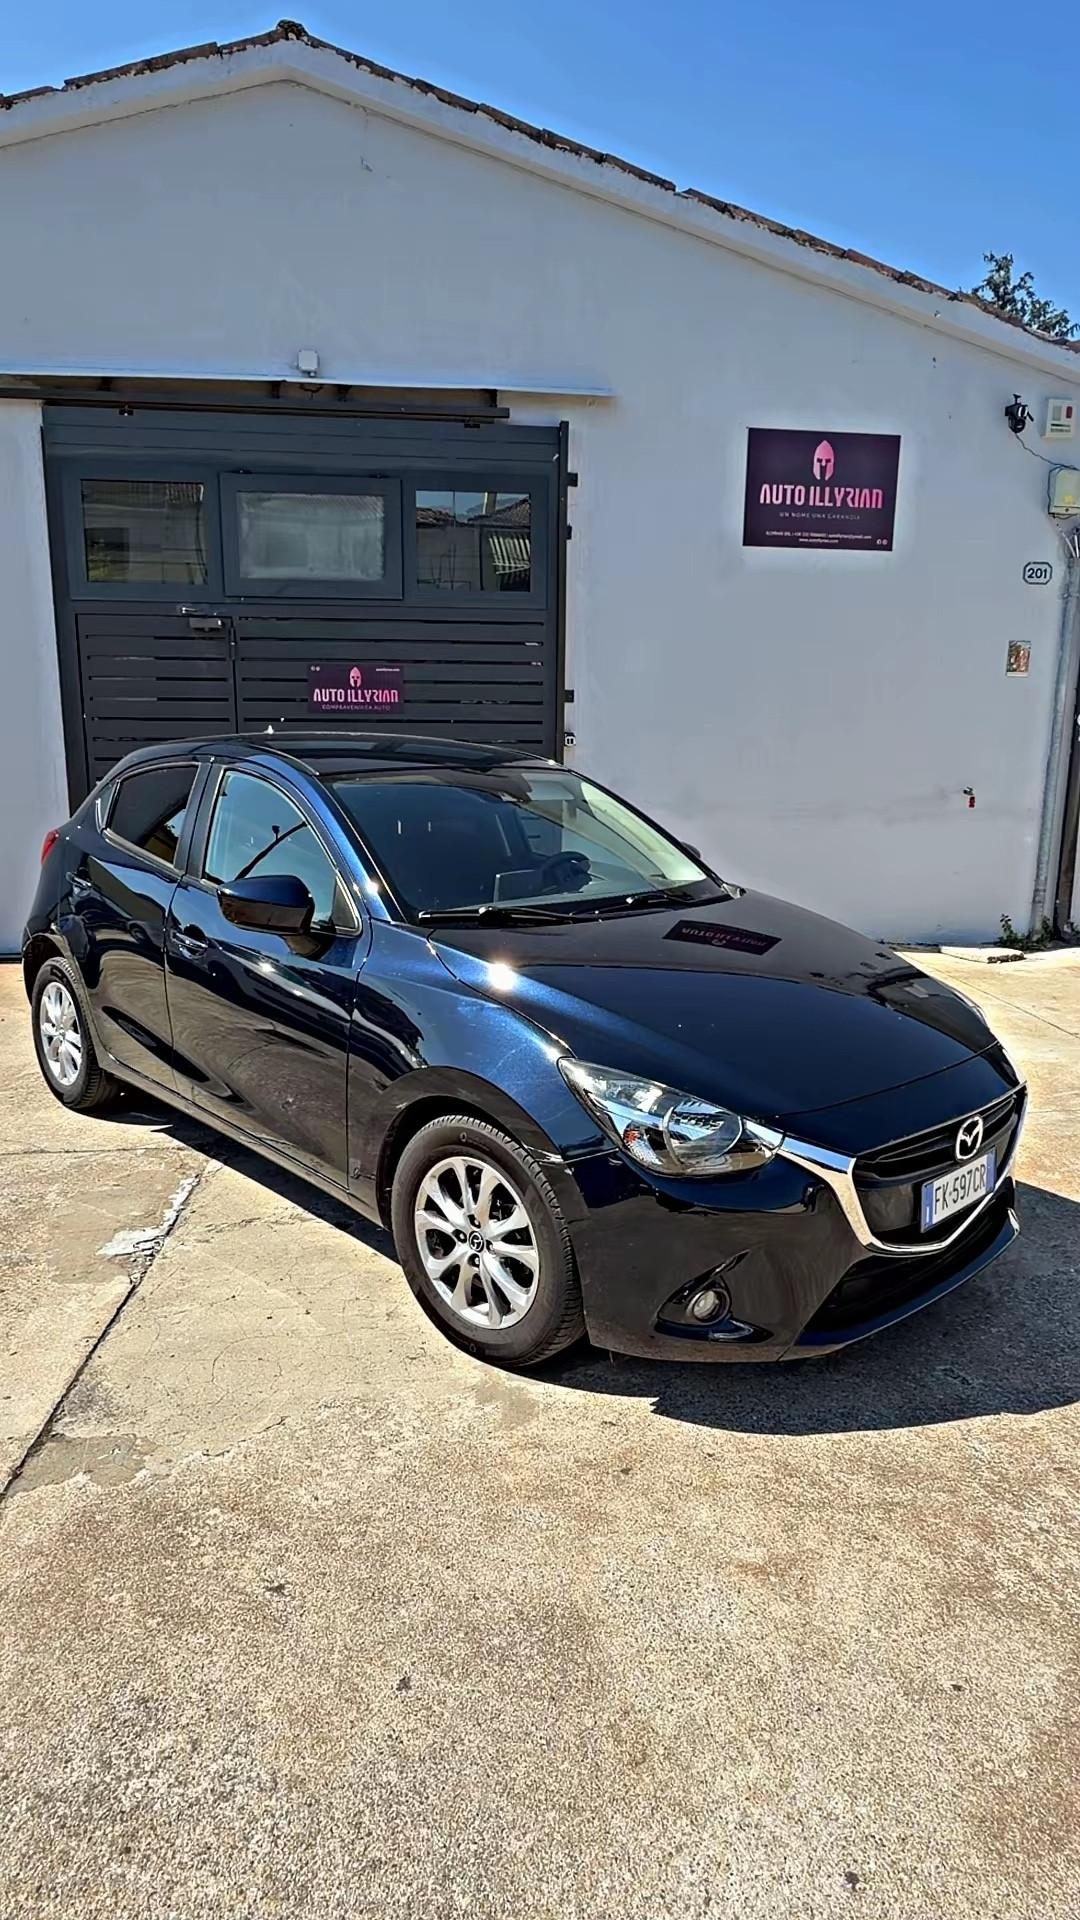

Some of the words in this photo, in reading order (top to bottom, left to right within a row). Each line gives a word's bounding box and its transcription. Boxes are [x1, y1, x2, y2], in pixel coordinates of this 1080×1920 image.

[760, 483, 806, 506] AUTO
[809, 486, 883, 509] ILLYRIAN
[1027, 568, 1047, 579] 201
[313, 688, 345, 702] AUTO
[347, 689, 399, 703] ILLYRIAN
